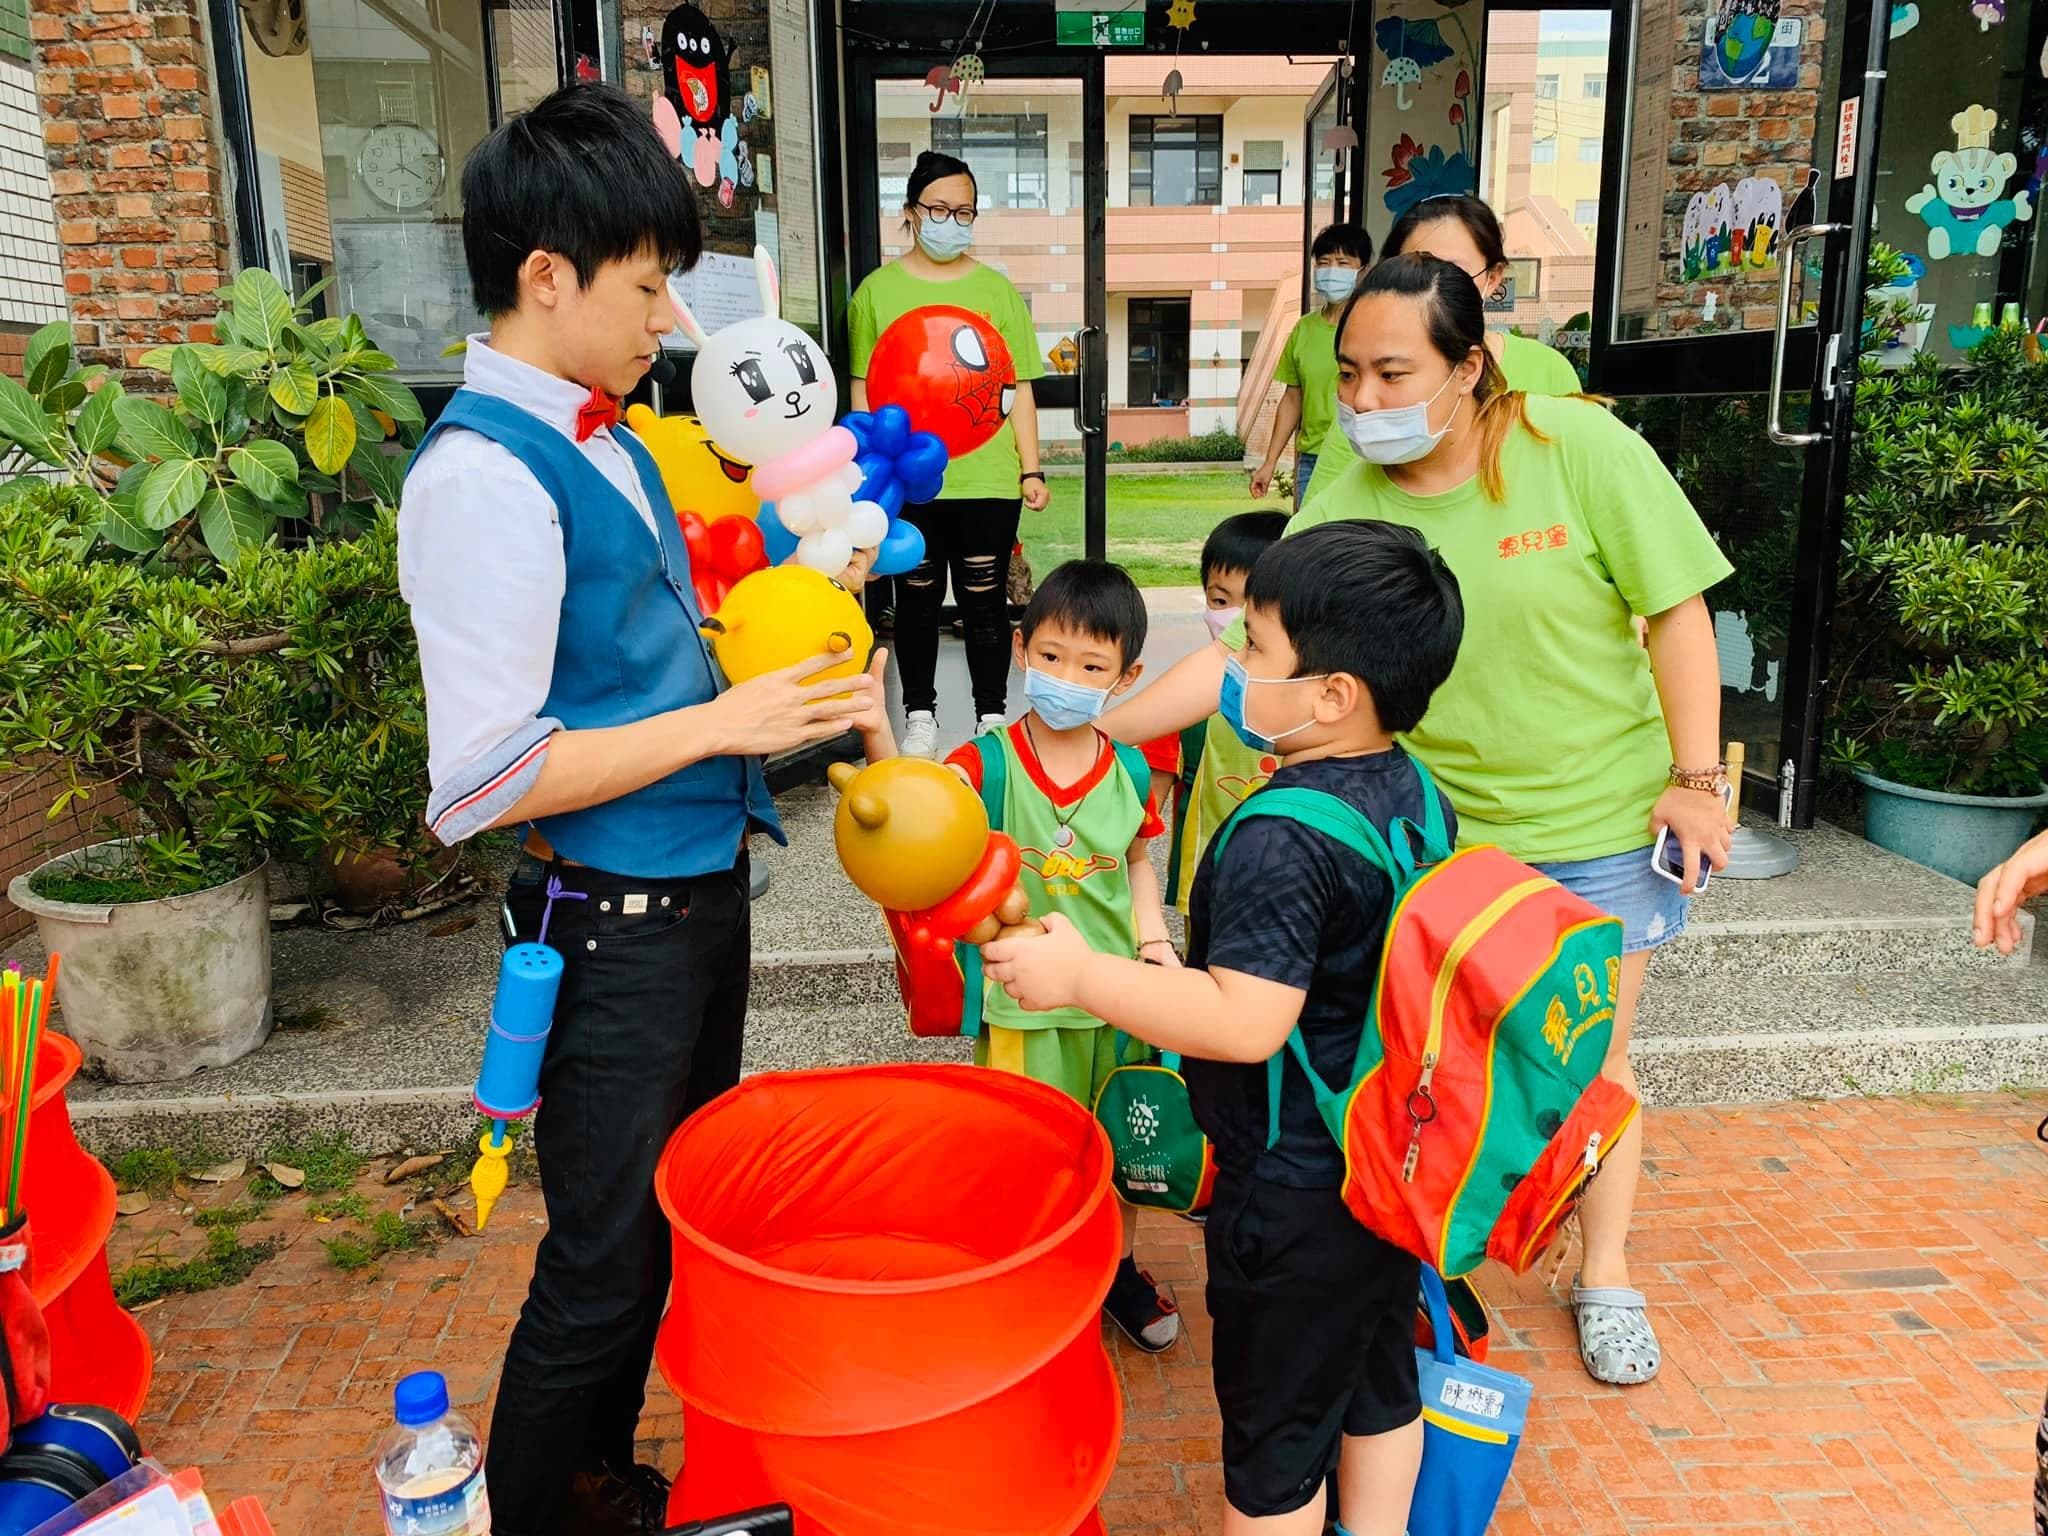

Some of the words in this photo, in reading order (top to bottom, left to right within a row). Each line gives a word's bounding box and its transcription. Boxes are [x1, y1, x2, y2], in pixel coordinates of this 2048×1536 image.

[1781, 20, 1794, 35] 街
[428, 161, 437, 172] 3
[376, 177, 385, 187] 8
[424, 176, 433, 186] 4
[388, 188, 395, 198] 7
